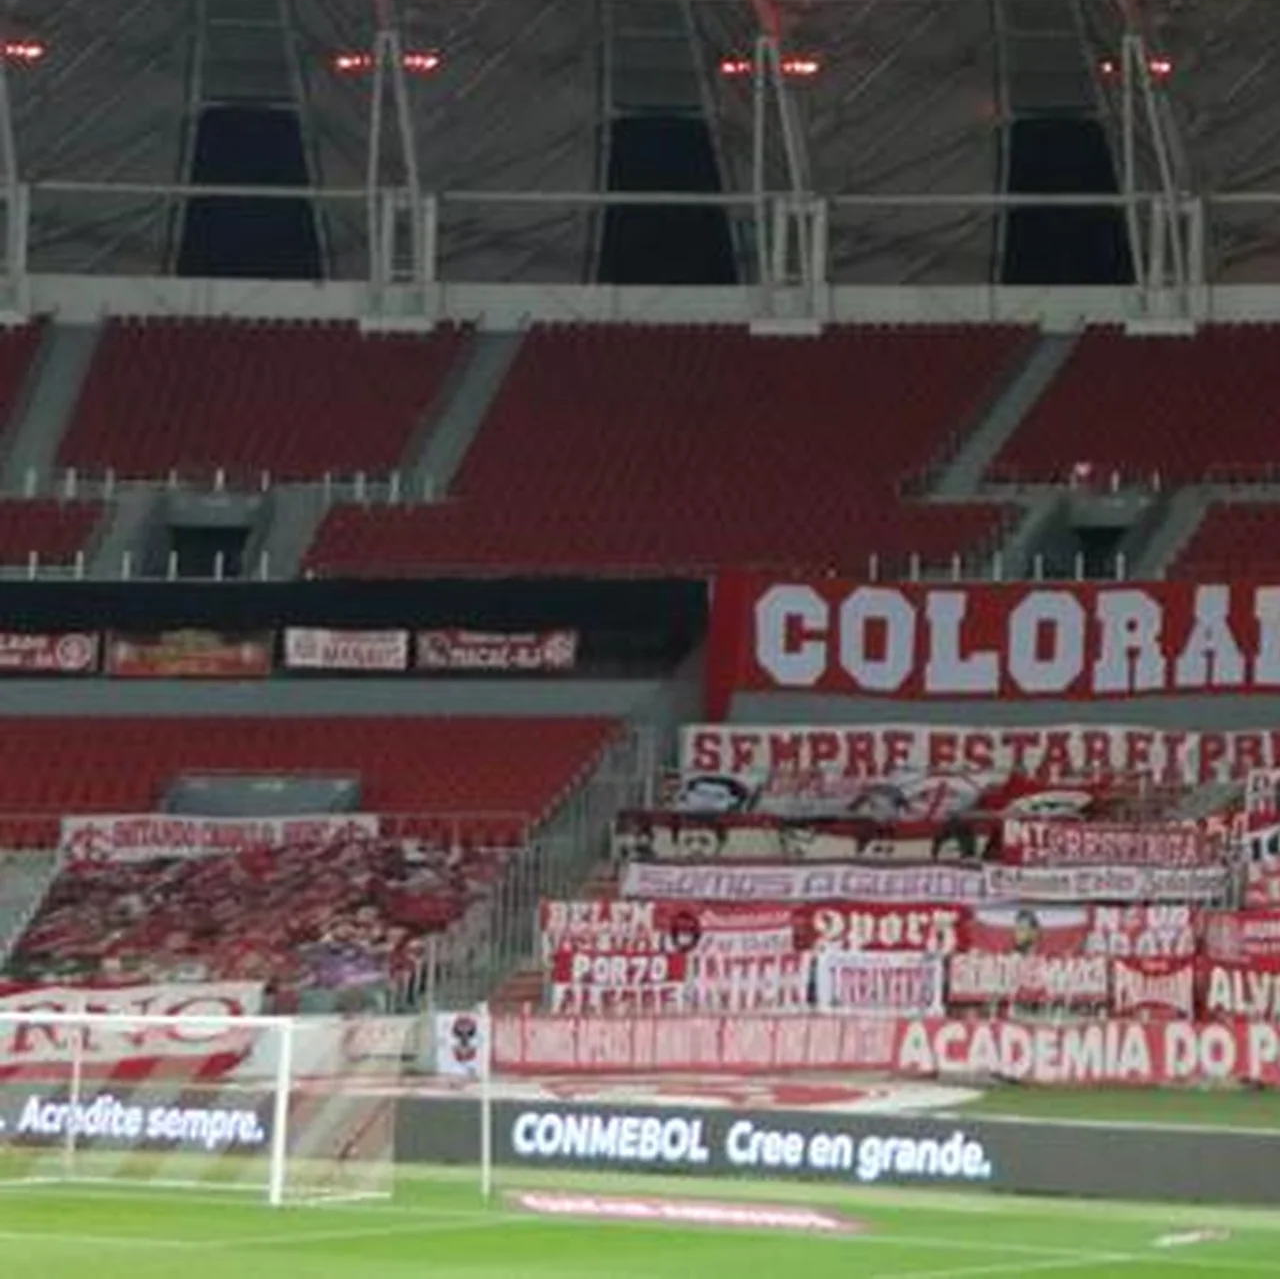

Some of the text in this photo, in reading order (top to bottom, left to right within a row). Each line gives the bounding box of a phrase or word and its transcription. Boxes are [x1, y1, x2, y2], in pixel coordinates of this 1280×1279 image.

[693, 730, 914, 778] SEMPRE
[929, 730, 1184, 783] ESTAREI
[899, 1021, 1149, 1082] ACADEMIA
[1164, 1022, 1237, 1081] DO
[18, 1094, 265, 1149] Acredite sempre.
[512, 1113, 992, 1181] CONMEBOL Cree en grande.
